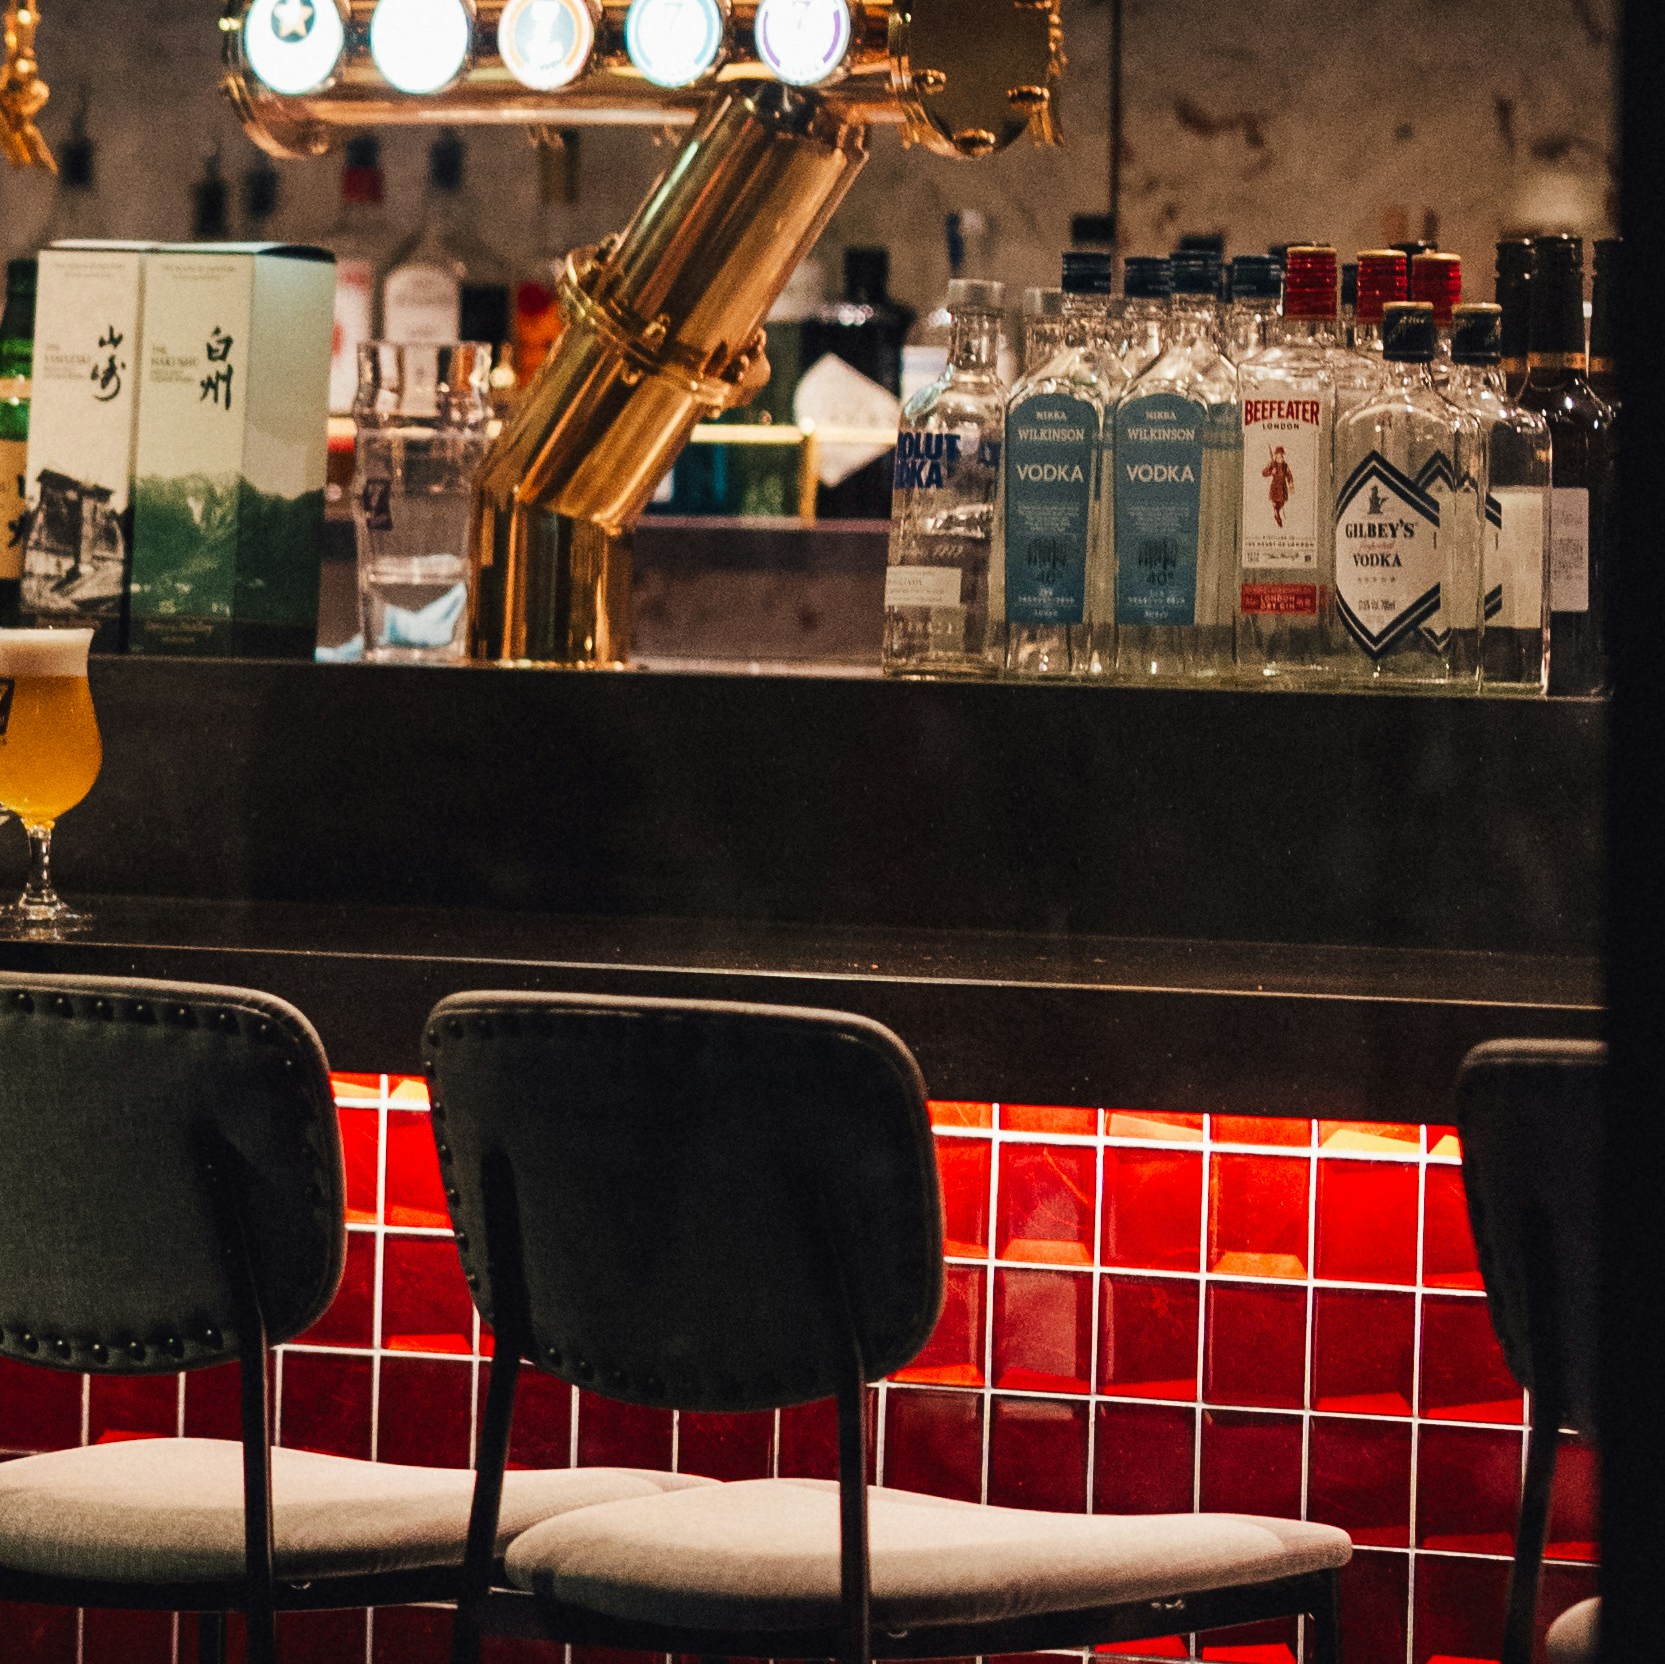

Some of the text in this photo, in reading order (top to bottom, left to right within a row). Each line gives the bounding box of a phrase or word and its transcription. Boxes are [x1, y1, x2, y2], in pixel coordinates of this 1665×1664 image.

[199, 325, 234, 411] 白州
[1244, 400, 1320, 426] BEEFEATER
[1017, 427, 1085, 442] WILKINSON
[1127, 427, 1195, 442] WILKINSON
[1262, 422, 1300, 430] LONDON
[897, 431, 961, 461] OLUT
[1017, 463, 1084, 483] VODKA
[1126, 463, 1195, 483] VODKA
[1345, 518, 1414, 538] GILBEY'S
[1353, 553, 1402, 567] VODKA
